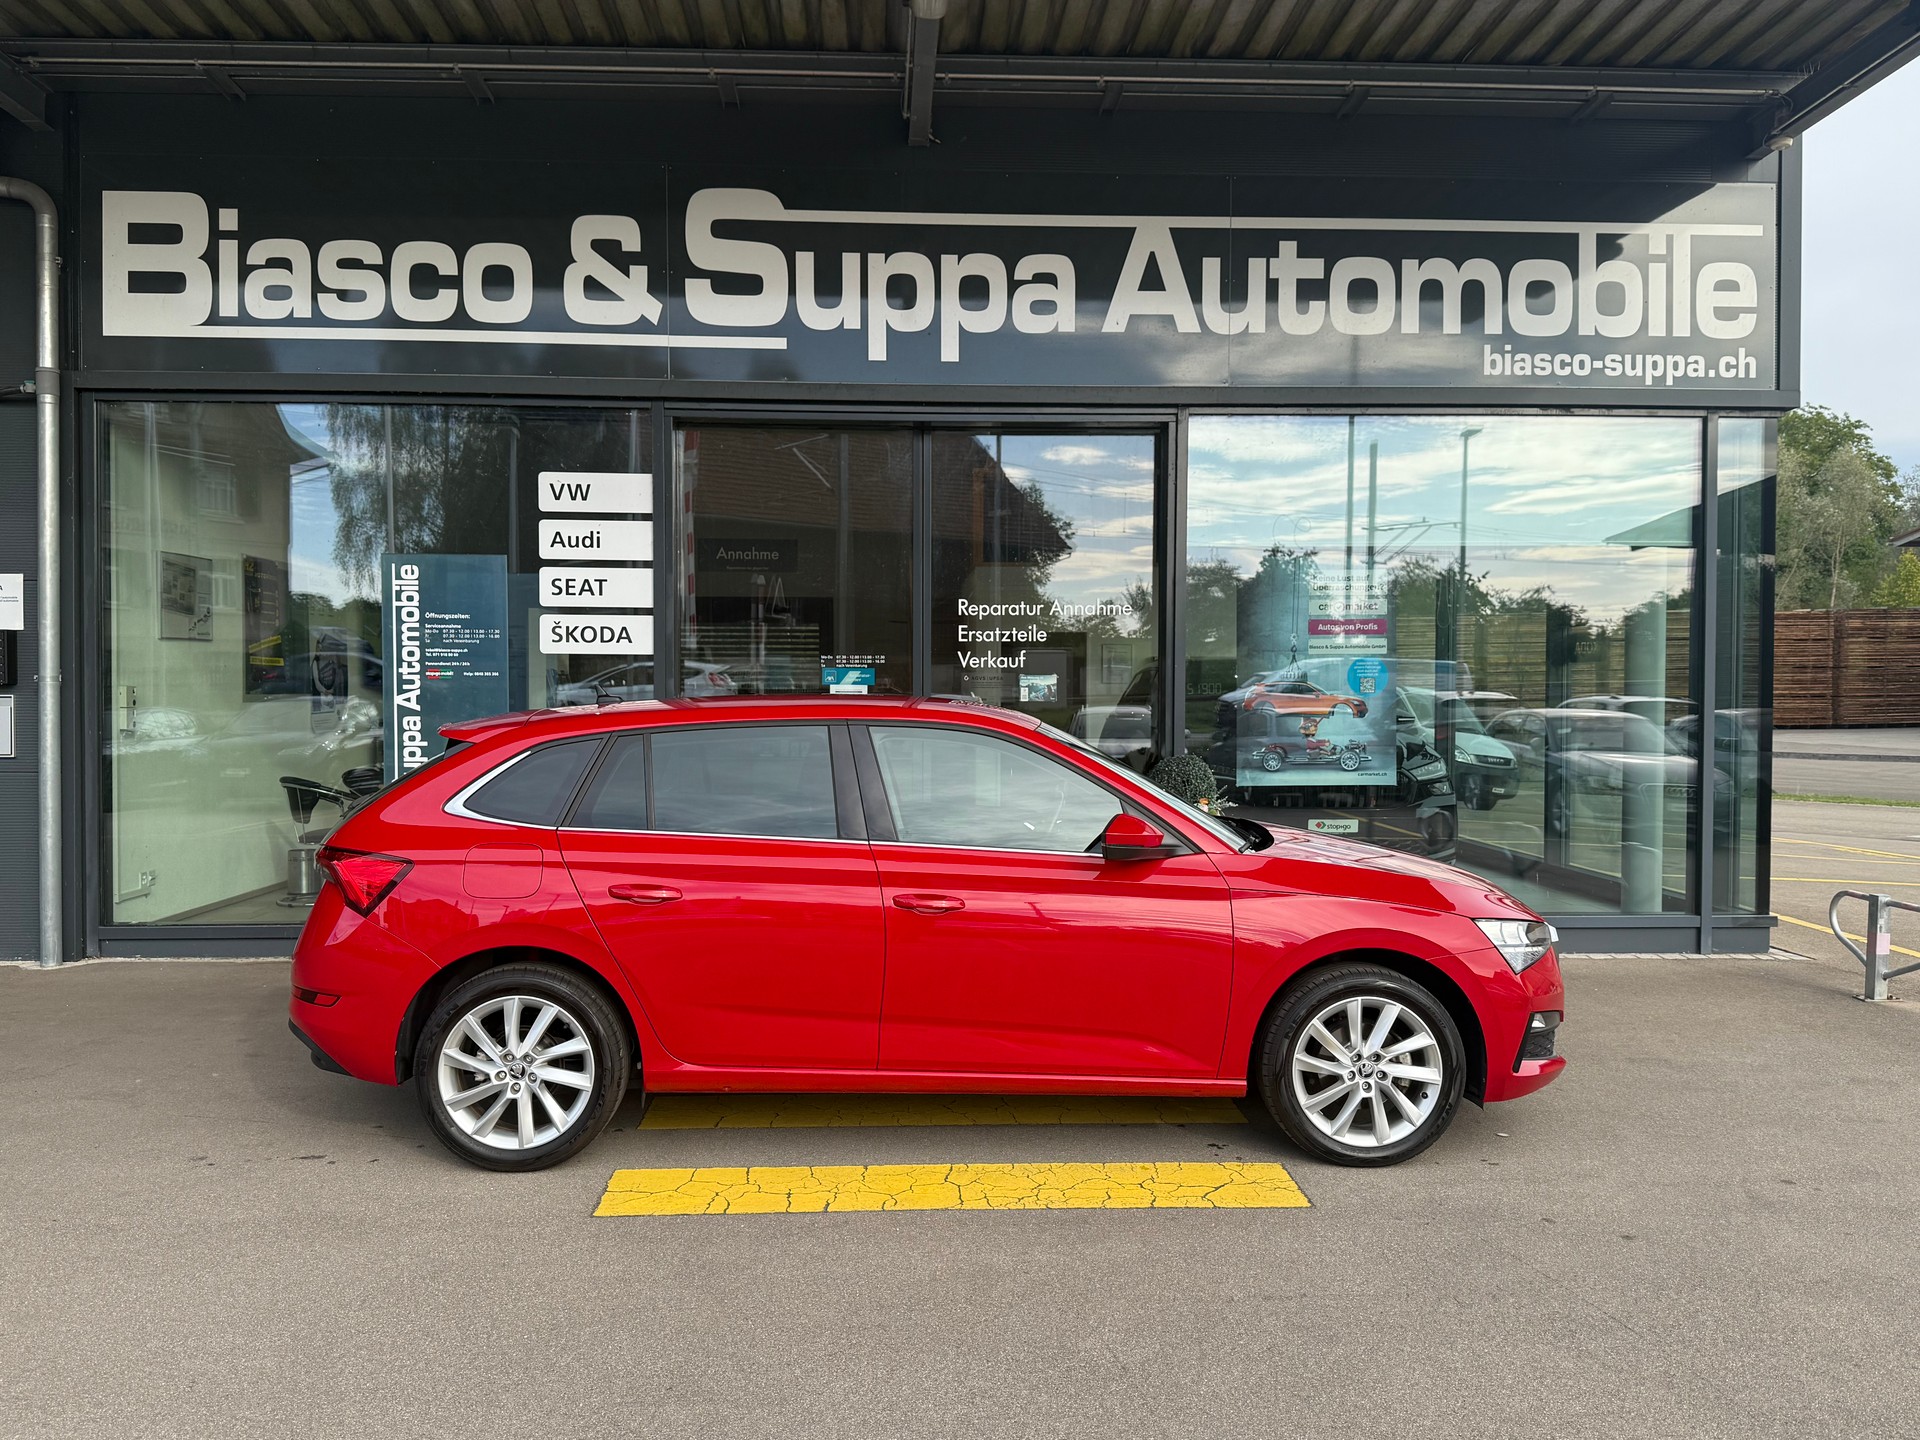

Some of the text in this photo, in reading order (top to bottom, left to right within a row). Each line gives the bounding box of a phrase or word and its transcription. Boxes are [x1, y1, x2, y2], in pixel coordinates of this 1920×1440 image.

[102, 187, 1759, 363] Biasco & Suppa Automobile
[1483, 344, 1757, 386] biasco-suppa.ch
[549, 483, 591, 501] VW
[549, 531, 601, 549] Audi
[716, 546, 779, 560] Annahme
[551, 578, 608, 596] SEAT
[425, 612, 471, 620] Öffnungszeiten:
[958, 598, 1133, 620] Reparatur Annahme
[551, 621, 633, 644] ŠKODA
[958, 625, 1048, 643] Ersatzteile
[1356, 623, 1378, 631] Profis
[397, 564, 421, 712] Automobile
[957, 650, 1026, 669] Verkauf
